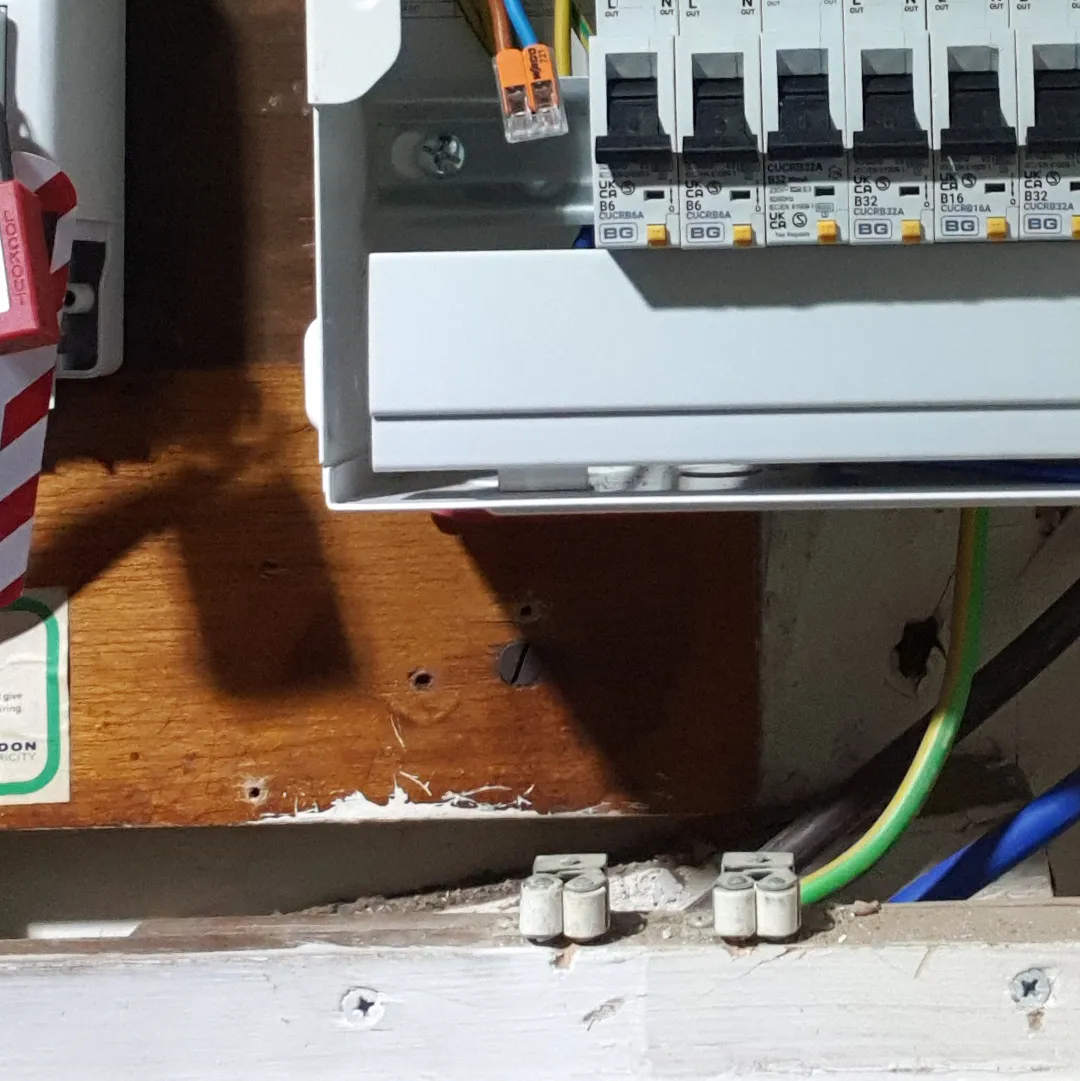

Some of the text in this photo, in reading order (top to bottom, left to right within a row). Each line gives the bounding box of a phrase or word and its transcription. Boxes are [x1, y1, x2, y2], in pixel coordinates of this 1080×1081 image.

[940, 172, 958, 181] UK
[1024, 171, 1042, 179] UK
[599, 180, 616, 189] UK
[685, 180, 703, 189] UK
[854, 176, 871, 184] UK
[1024, 180, 1042, 189] CA
[854, 185, 872, 194] CA
[940, 182, 958, 191] CA
[599, 189, 617, 198] CA
[685, 189, 704, 198] CA
[1024, 190, 1047, 201] B32
[854, 196, 877, 206] B32
[941, 193, 964, 204] B16
[600, 201, 615, 211] B6
[686, 201, 701, 211] B6
[769, 212, 784, 220] UK
[770, 220, 786, 230] CA
[945, 220, 975, 232] BG
[1028, 218, 1058, 229] BG
[604, 227, 634, 239] BG
[690, 227, 720, 238] BG
[858, 223, 888, 235] BG
[3, 693, 23, 702] give
